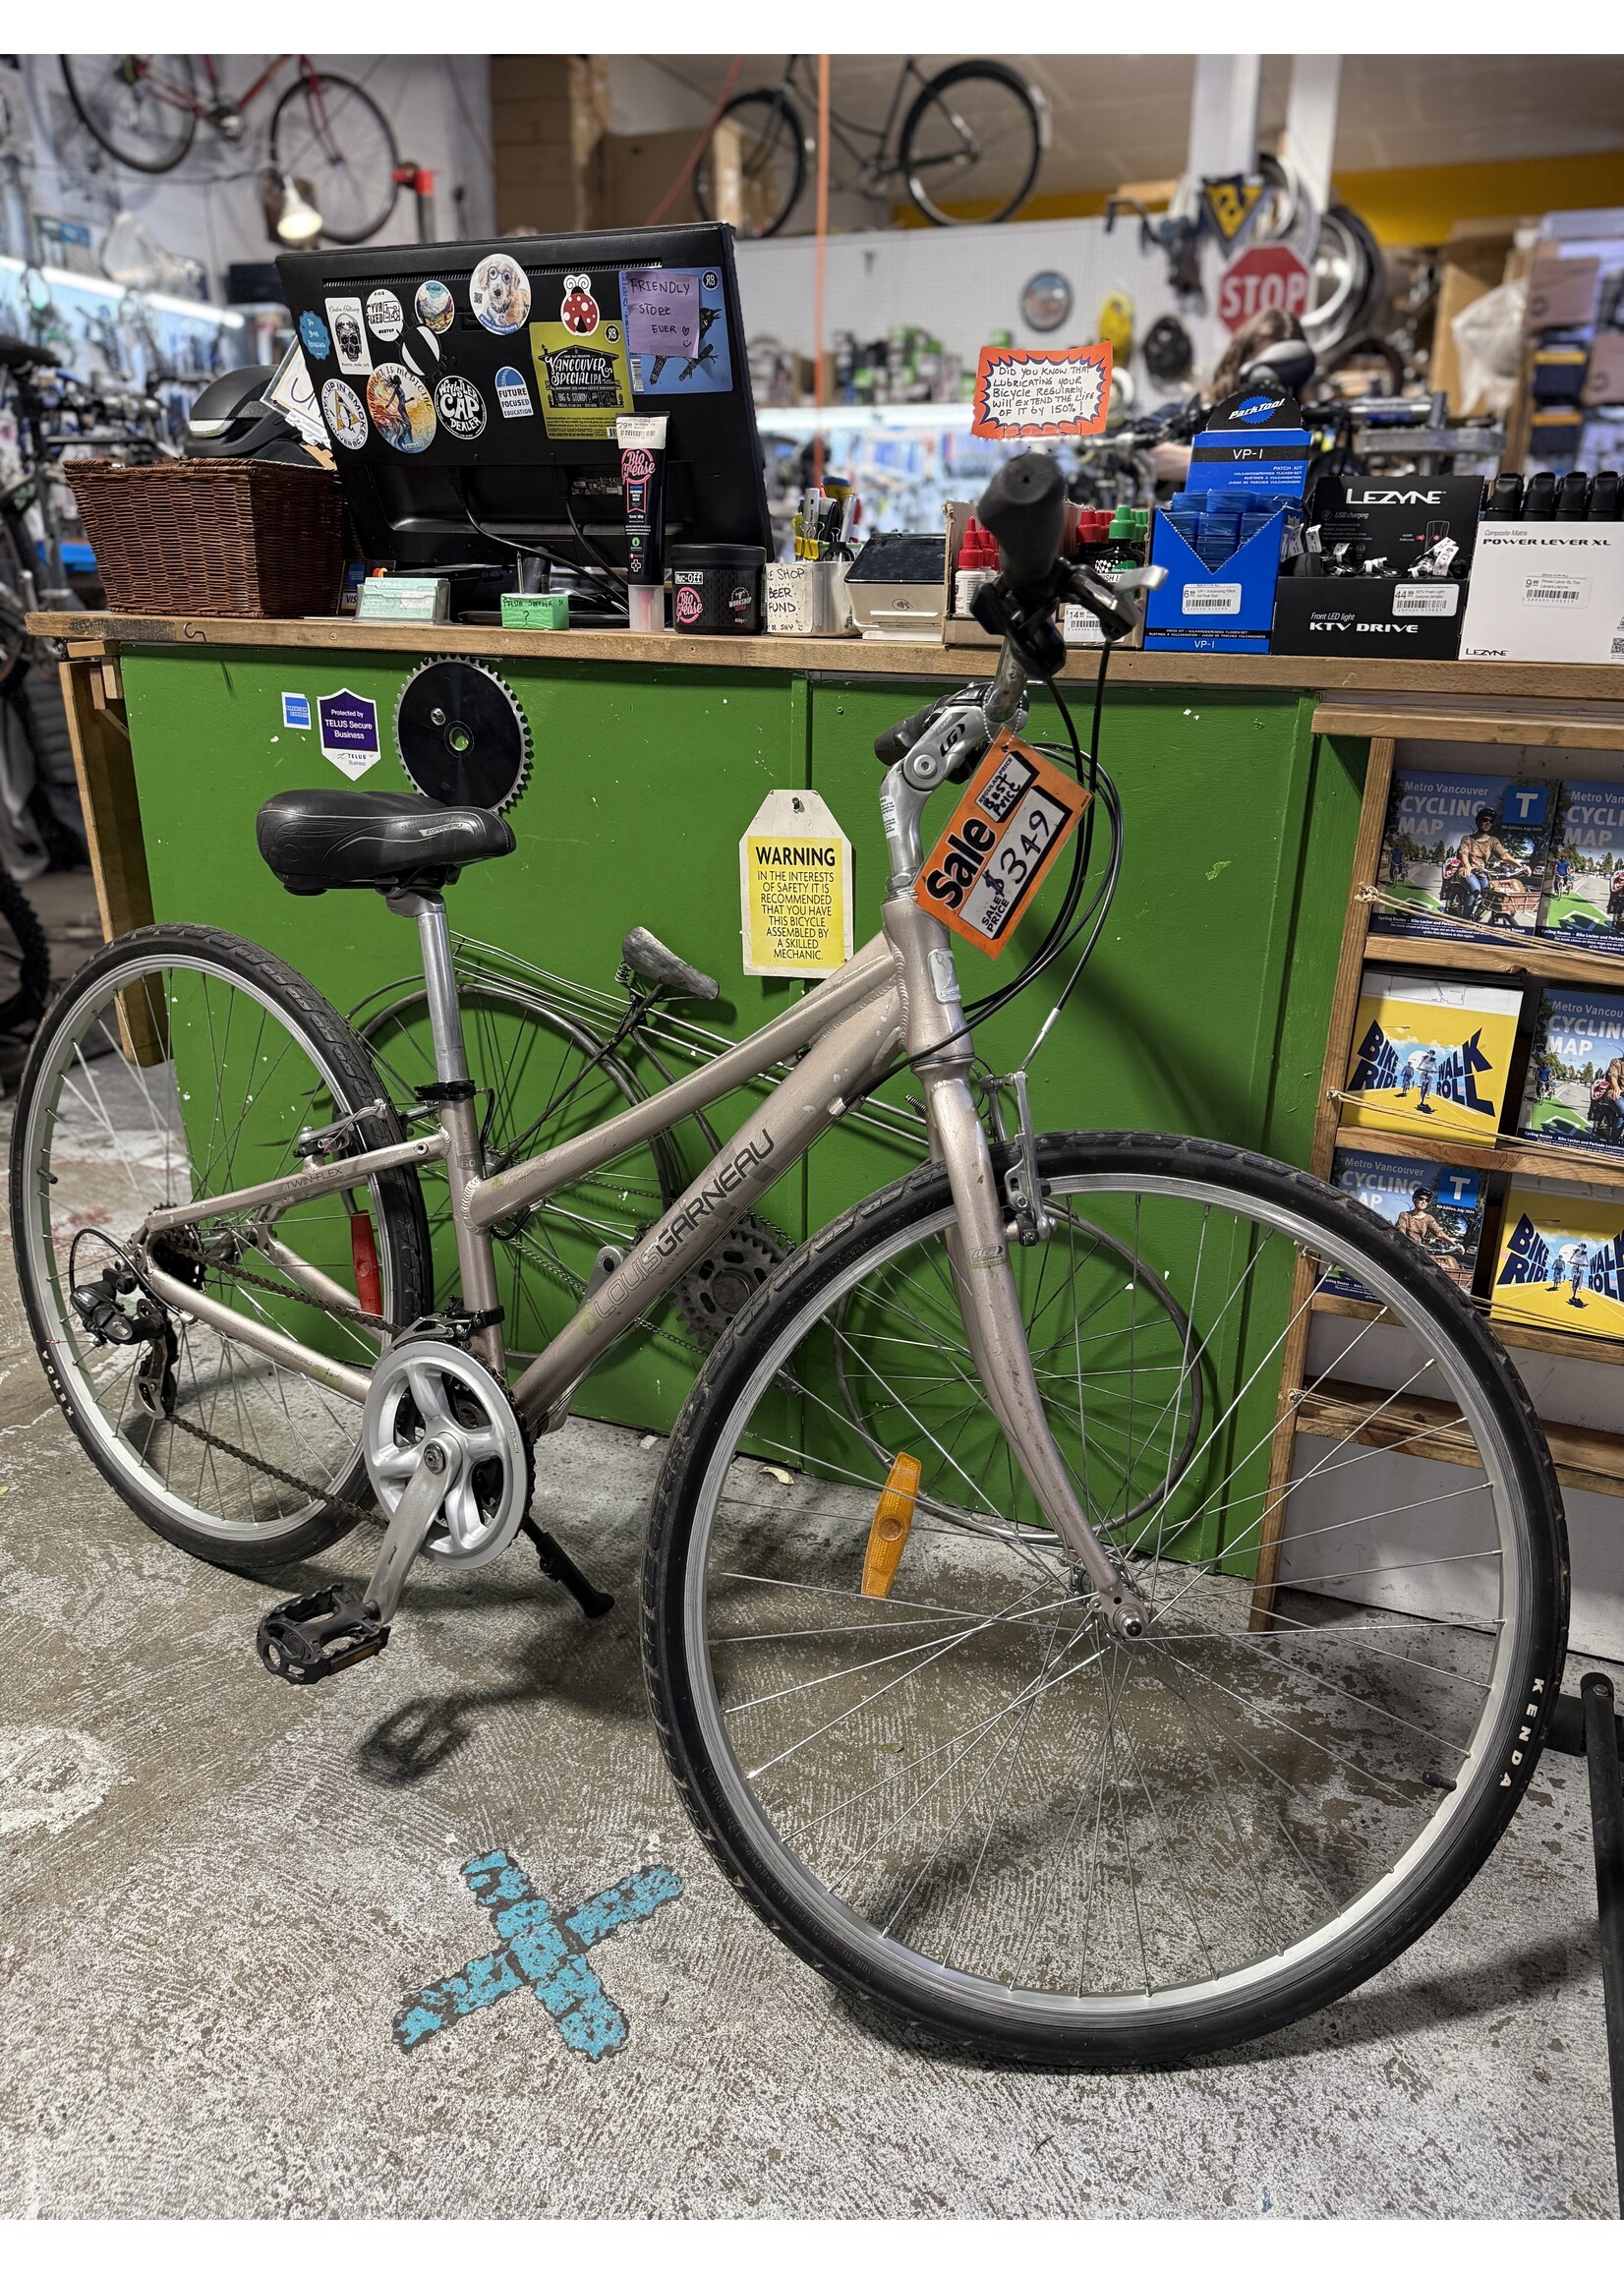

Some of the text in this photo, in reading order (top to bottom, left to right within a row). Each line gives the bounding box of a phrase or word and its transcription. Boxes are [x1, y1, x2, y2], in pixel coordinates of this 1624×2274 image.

[630, 278, 690, 295] FRIENDLY
[1222, 272, 1306, 319] STOP
[545, 351, 613, 378] VANCOUVER
[551, 372, 603, 386] SPECIAL IPA
[438, 379, 481, 401] WHISTLER
[498, 388, 528, 398] FUTURE
[325, 381, 367, 438] UP IN SMOKE
[439, 394, 481, 421] CAP
[500, 399, 531, 409] FOCUSED
[503, 408, 533, 418] EDUCATION
[449, 417, 482, 433] DEALER
[626, 449, 646, 466] Bio
[1345, 488, 1443, 505] LEZYNE
[1483, 529, 1511, 538] Composite
[1481, 538, 1537, 547] POWER
[777, 567, 805, 580] SHOP
[346, 595, 357, 604] VIS
[768, 587, 793, 599] BEER
[728, 597, 752, 608] WORKSHOP
[768, 602, 796, 613] FUND
[1310, 612, 1327, 620] Front
[1340, 612, 1356, 621] light
[1308, 621, 1420, 634] KTV DRIVE
[1465, 647, 1510, 657] LEZYNE
[330, 708, 365, 720] Protected by
[324, 718, 374, 731] TELUS Secure
[334, 729, 366, 740] Business
[347, 752, 368, 761] TELUS
[999, 757, 1013, 776] PRICE
[1404, 781, 1490, 796] Metro Vancouver
[1571, 790, 1602, 803] Metro
[1400, 794, 1486, 818] CYCLING
[1515, 791, 1539, 818] T
[1397, 815, 1444, 836] MAP
[1563, 827, 1613, 846] MAP
[755, 845, 836, 867] WARNING
[925, 818, 996, 910] Sale
[757, 871, 835, 883] IN THE INTERESTS
[762, 882, 830, 894] OF SAFETY IT IS
[760, 893, 833, 904] RECOMMENDED
[762, 904, 833, 916] THAT YOU HAVE
[981, 896, 1002, 926] SALE
[986, 898, 1011, 933] PRICE
[768, 915, 826, 928] THIS BICYCLE
[766, 926, 830, 939] ASSEMBLED BY
[777, 938, 819, 949] A SKILLED
[773, 949, 824, 961] MECHANIC.
[1551, 1000, 1624, 1019] Metro Vancou
[1548, 1015, 1624, 1040] CYCLIN
[1357, 1019, 1494, 1082] BIKE WALK
[1544, 1034, 1594, 1057] MAP
[1347, 1059, 1496, 1118] RIDE ROLL
[1344, 1157, 1424, 1177] Metro Vancouver
[285, 1167, 343, 1190] TWIN-FLEX
[1342, 1170, 1422, 1195] CYCLING
[1449, 1175, 1472, 1200] T
[1506, 1212, 1551, 1265] BIKE
[1496, 1252, 1549, 1285] RIDE
[1499, 1677, 1545, 1787] KENDA
